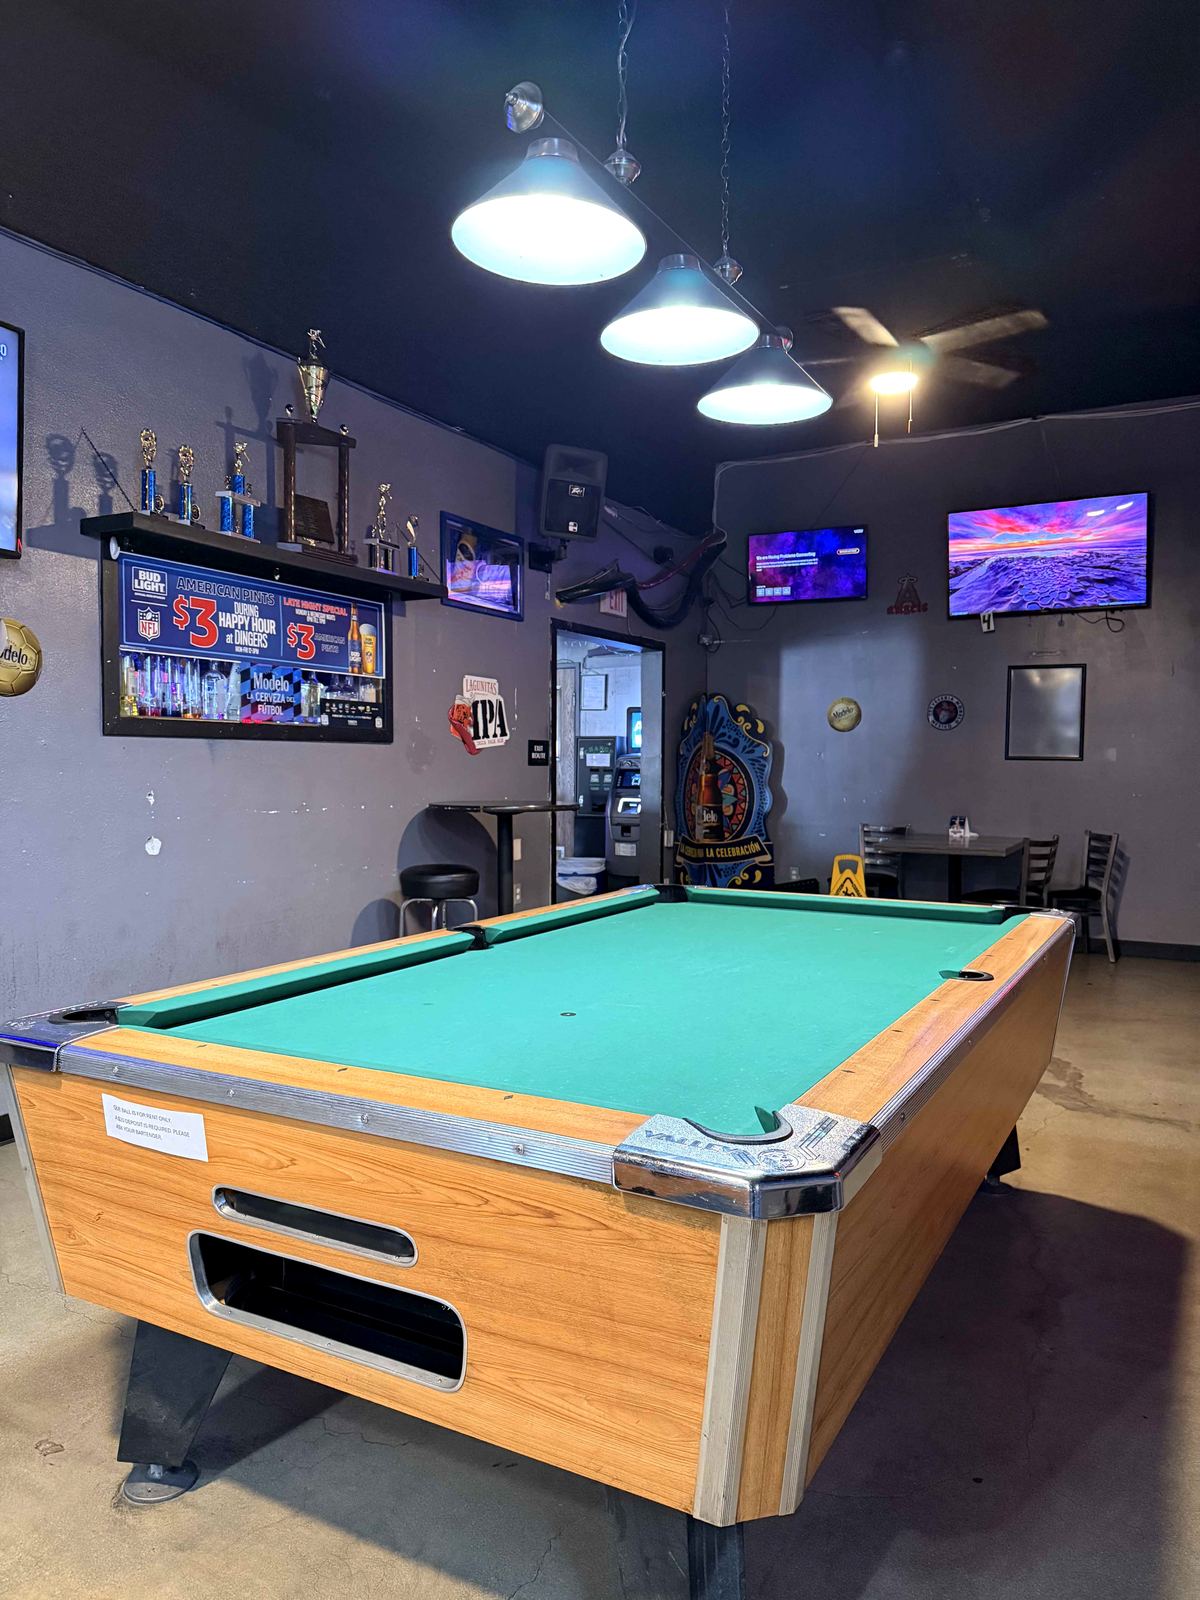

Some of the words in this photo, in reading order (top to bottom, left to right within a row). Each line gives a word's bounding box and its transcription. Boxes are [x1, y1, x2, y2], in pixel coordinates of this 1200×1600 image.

[138, 570, 161, 582] BUD
[134, 579, 166, 592] LIGHT
[176, 576, 240, 600] AMERICAN
[242, 588, 275, 606] PINTS
[234, 601, 259, 618] DURING
[283, 596, 300, 608] LATE
[300, 600, 322, 612] NIGHT
[322, 604, 348, 616] SPECIAL
[141, 620, 158, 636] NFL
[173, 594, 218, 648] $3
[218, 612, 250, 630] HAPPY
[252, 616, 276, 635] HOUR
[226, 633, 234, 644] at
[234, 630, 268, 648] DINGERS
[286, 622, 316, 660] $3
[254, 672, 289, 692] Modelo
[466, 678, 496, 695] LAGUNITAS
[246, 691, 254, 700] LA
[255, 692, 286, 704] CERVEZA
[258, 702, 284, 716] FÚTBOL
[472, 699, 508, 740] IPA
[706, 848, 714, 858] LA
[716, 841, 760, 858] CELEBRACIÓN
